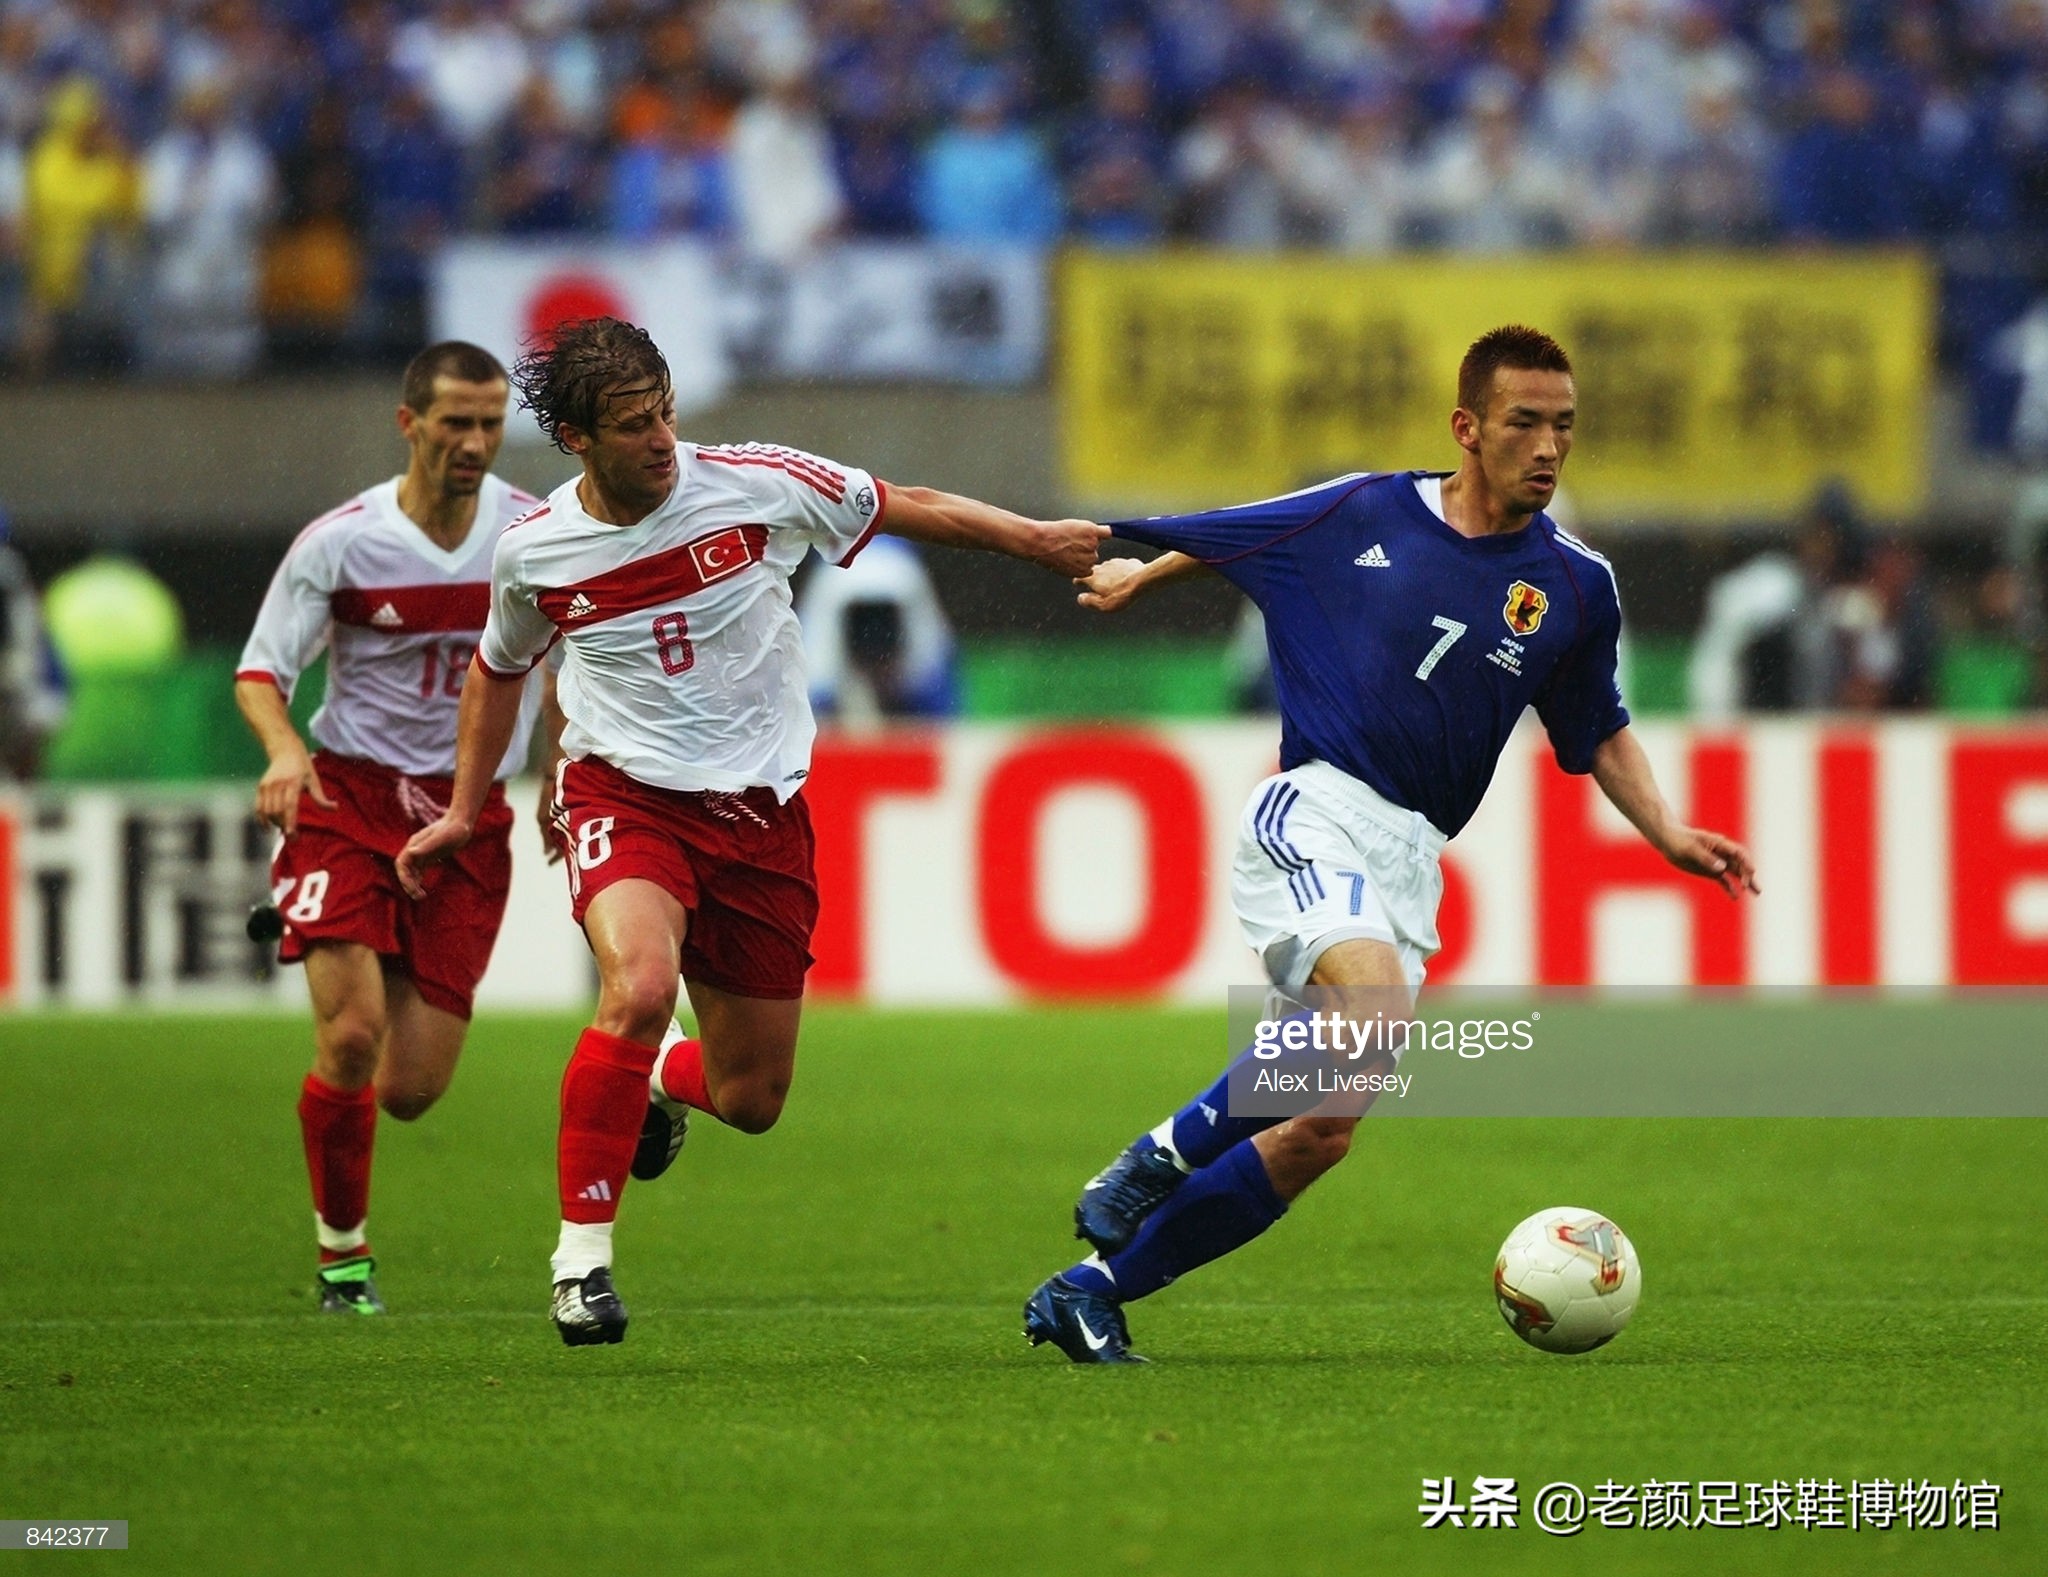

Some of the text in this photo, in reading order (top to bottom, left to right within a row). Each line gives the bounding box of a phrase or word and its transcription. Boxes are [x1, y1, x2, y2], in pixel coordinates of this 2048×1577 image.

[652, 611, 695, 677] 8
[1414, 614, 1468, 681] 7
[1500, 637, 1525, 654] JAPAN
[577, 816, 615, 870] 8
[1335, 871, 1364, 916] 7
